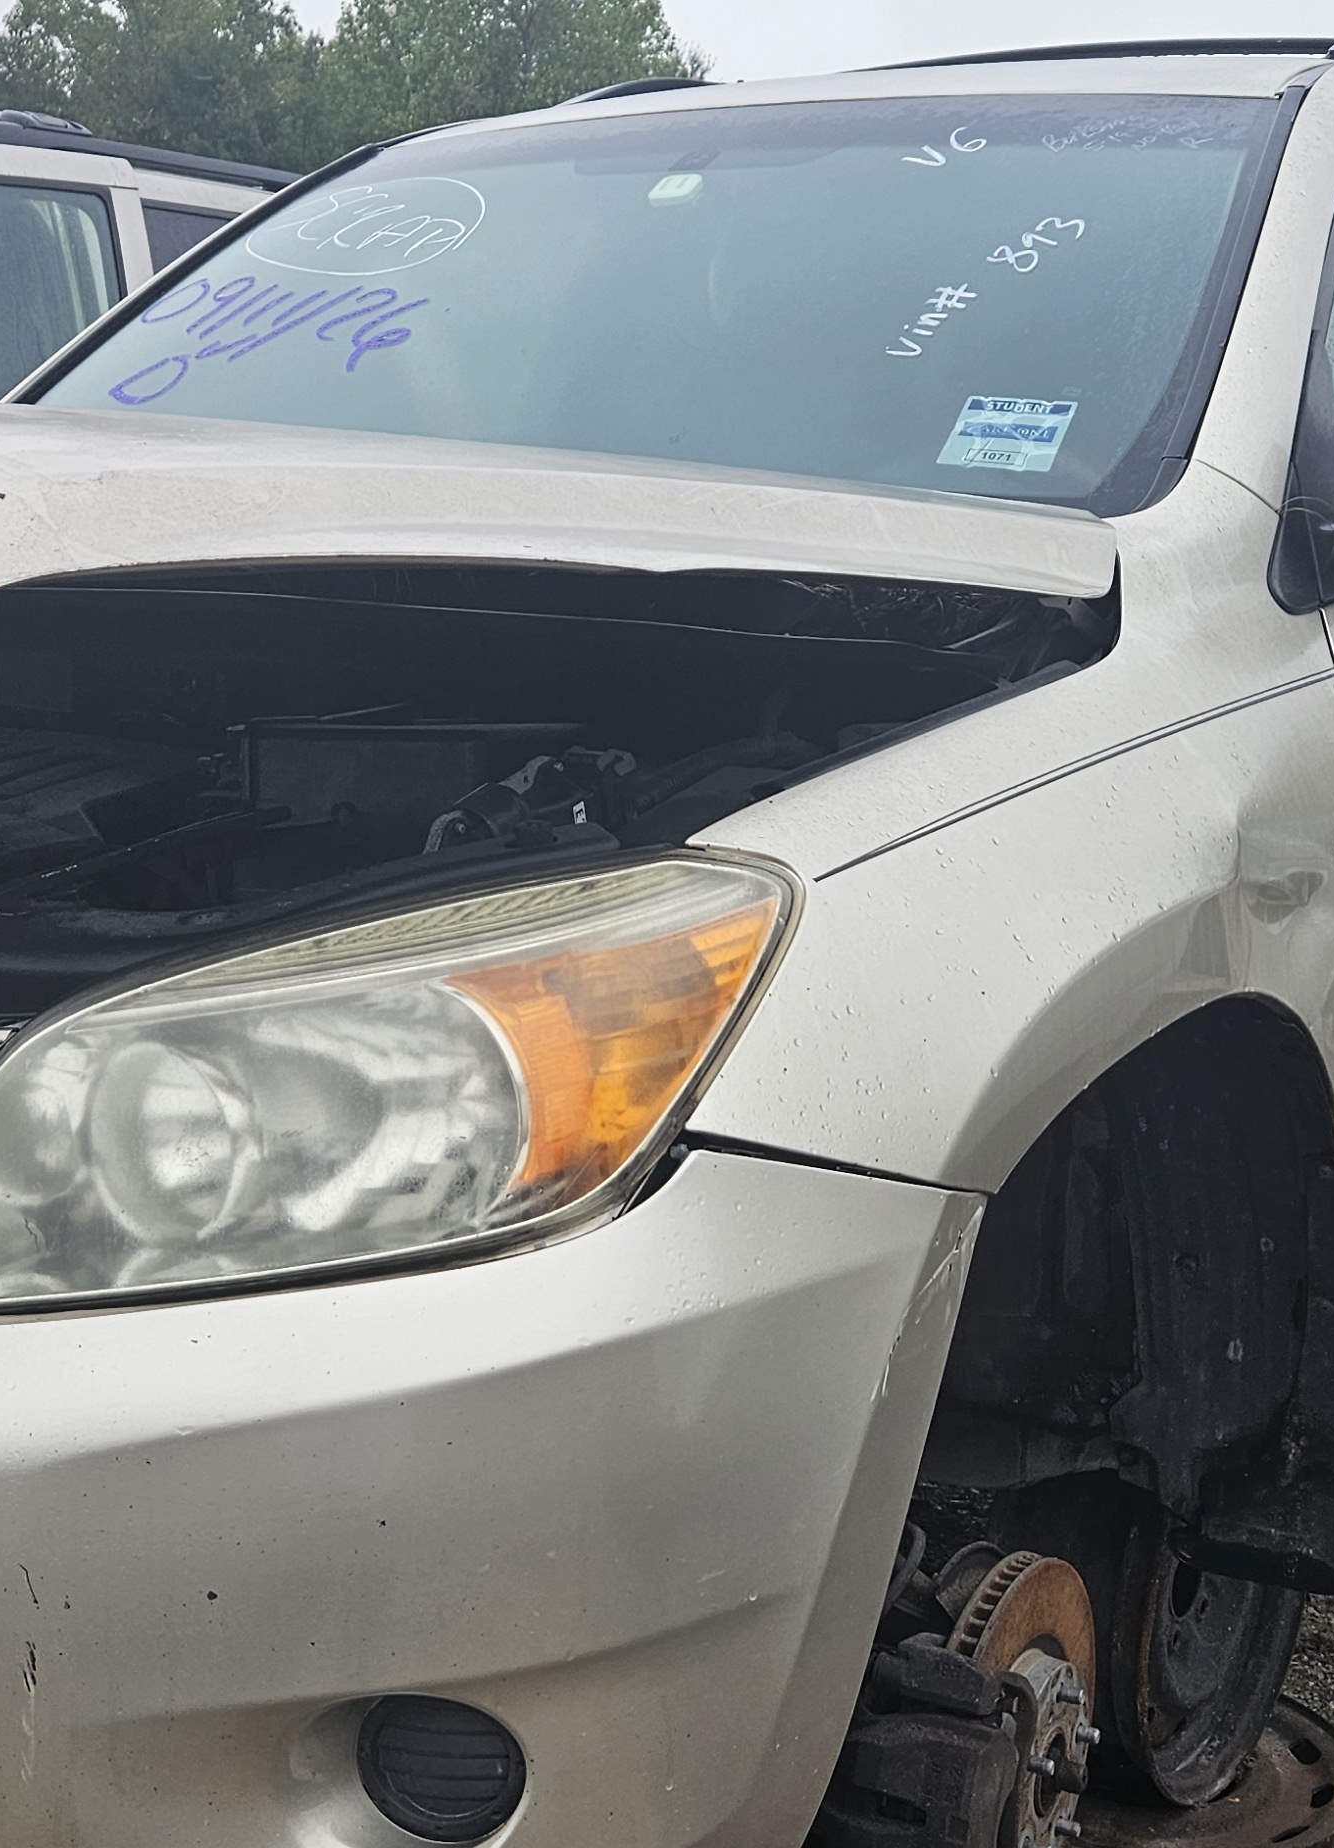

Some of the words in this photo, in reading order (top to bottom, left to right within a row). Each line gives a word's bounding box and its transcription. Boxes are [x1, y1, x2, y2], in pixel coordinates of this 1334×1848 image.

[987, 217, 1085, 272] 893
[986, 401, 1054, 414] STUDENT
[981, 451, 1012, 462] 1071
